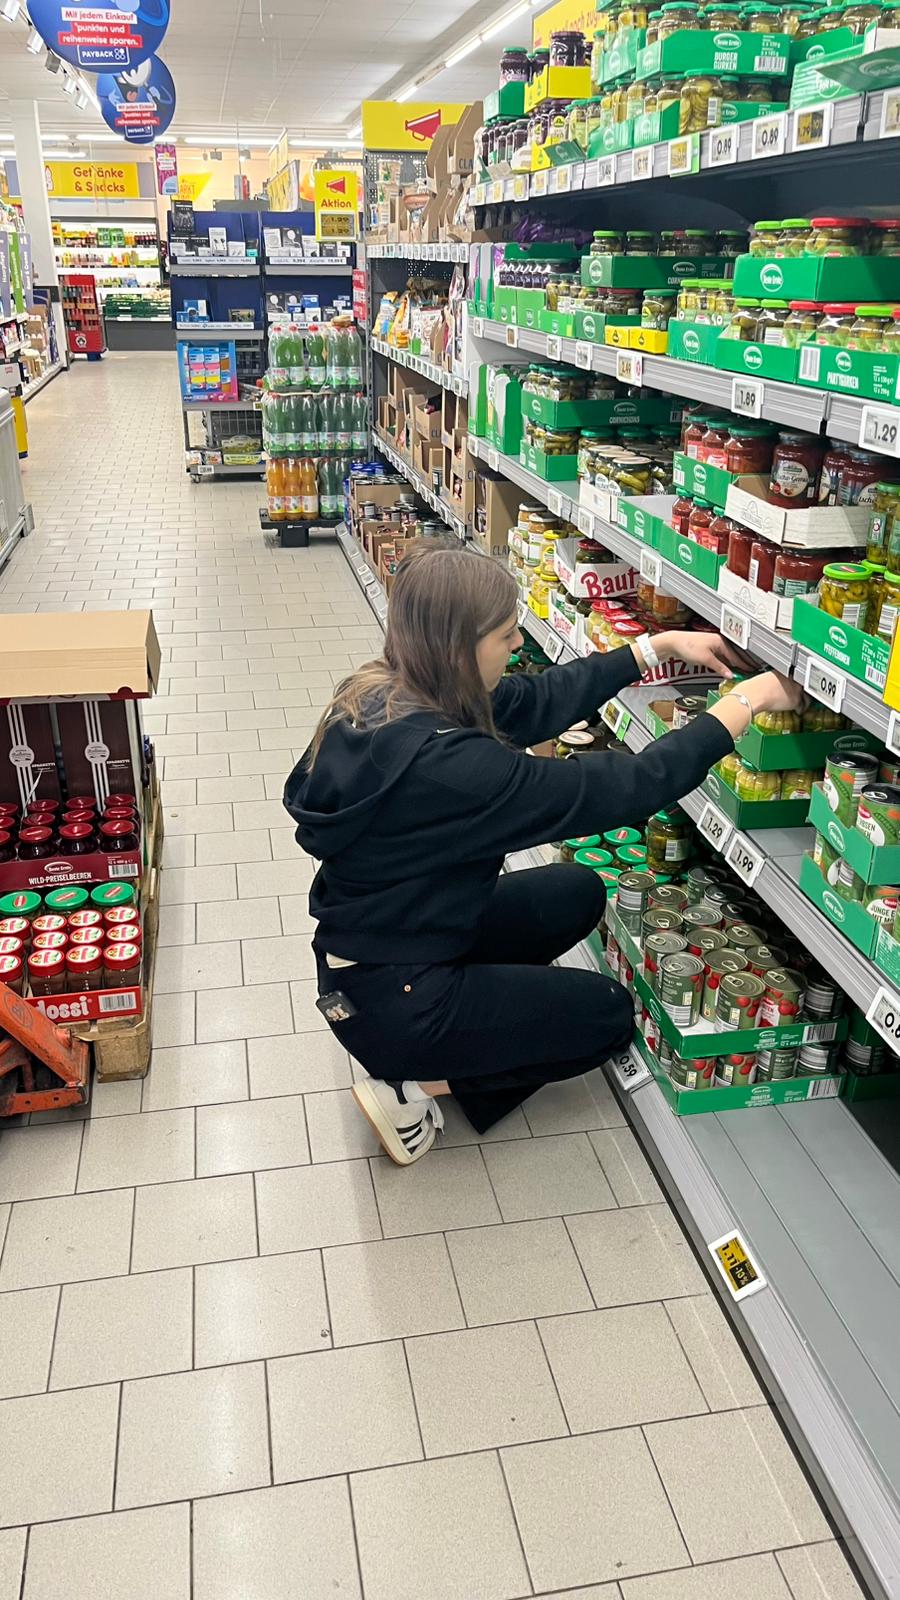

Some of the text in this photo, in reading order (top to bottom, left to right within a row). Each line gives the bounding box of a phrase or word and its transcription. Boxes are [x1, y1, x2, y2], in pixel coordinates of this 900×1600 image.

[65, 10, 134, 21] Mit jedem Einkauf
[110, 25, 125, 34] und
[63, 35, 138, 46] reihenweise sparen.
[82, 50, 114, 58] PAYBACK
[714, 52, 738, 61] BURGER
[713, 60, 738, 71] GURKEN
[73, 166, 124, 178] Getänke
[75, 181, 83, 192] &
[320, 199, 352, 208] Aktion
[740, 390, 756, 407] 1.89
[873, 422, 898, 444] 1.29
[820, 677, 837, 698] 0.99
[707, 817, 723, 839] 1.29
[736, 849, 754, 873] 1.99
[28, 871, 92, 885] WILD-PREISELBEEREN
[620, 1055, 638, 1077] 0.59
